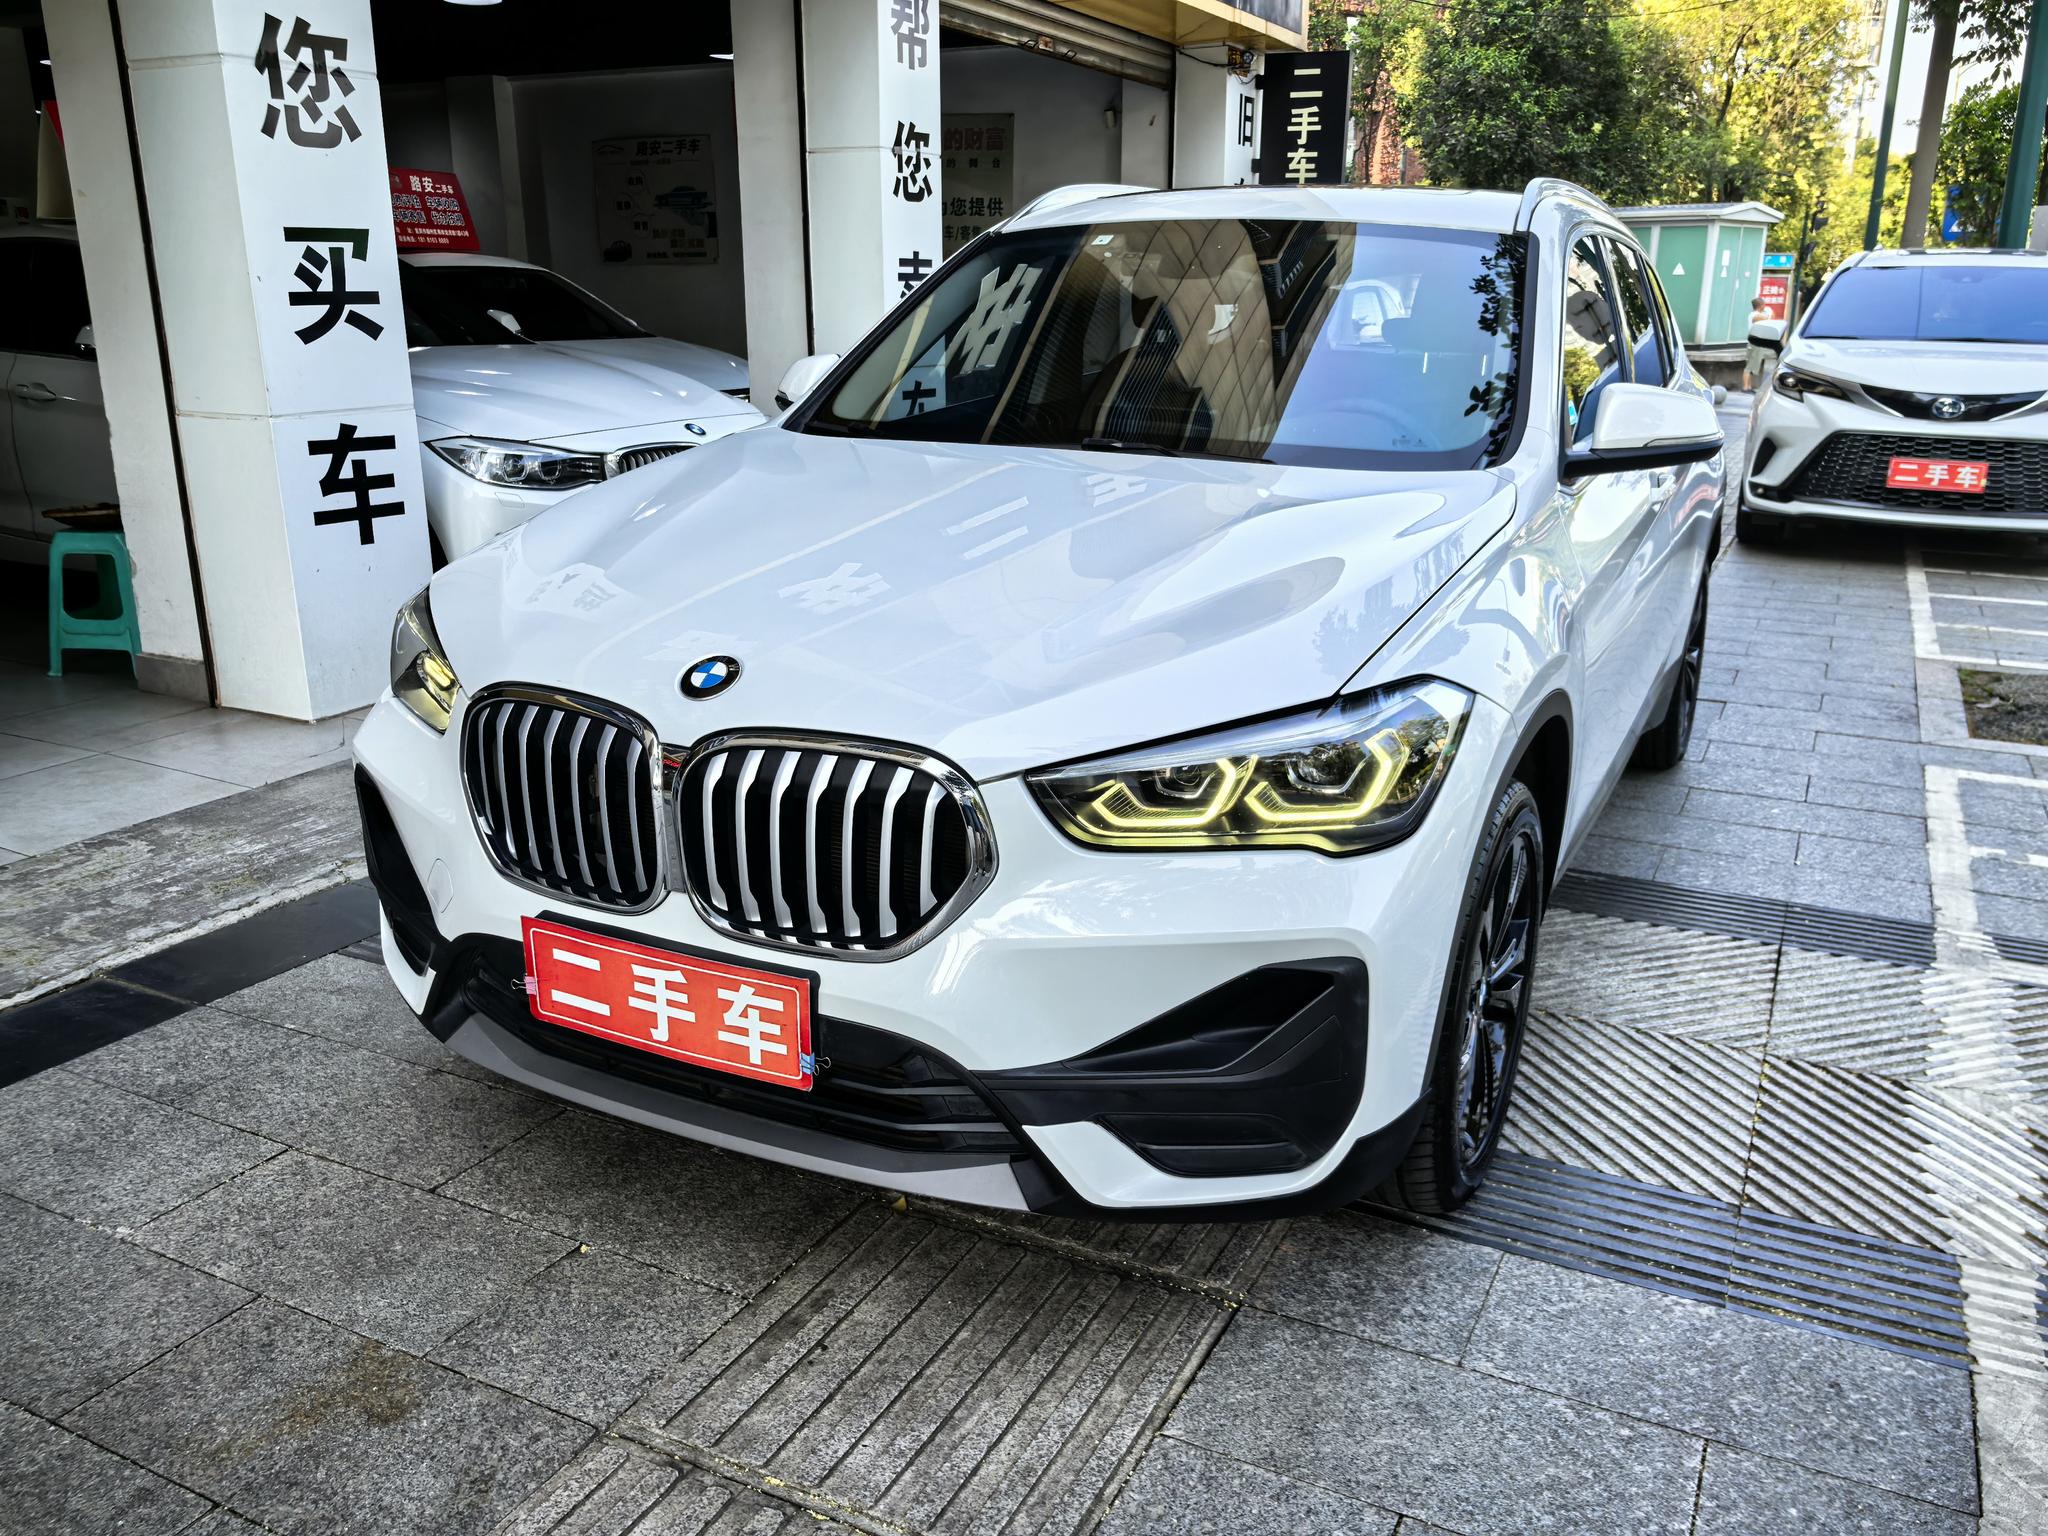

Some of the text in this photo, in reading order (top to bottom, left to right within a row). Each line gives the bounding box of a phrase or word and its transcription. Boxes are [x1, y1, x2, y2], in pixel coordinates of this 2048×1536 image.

[1285, 68, 1323, 185] 二手车
[254, 13, 406, 546] 您买车
[1894, 463, 1980, 489] 二手车
[551, 948, 788, 1066] 二手车
